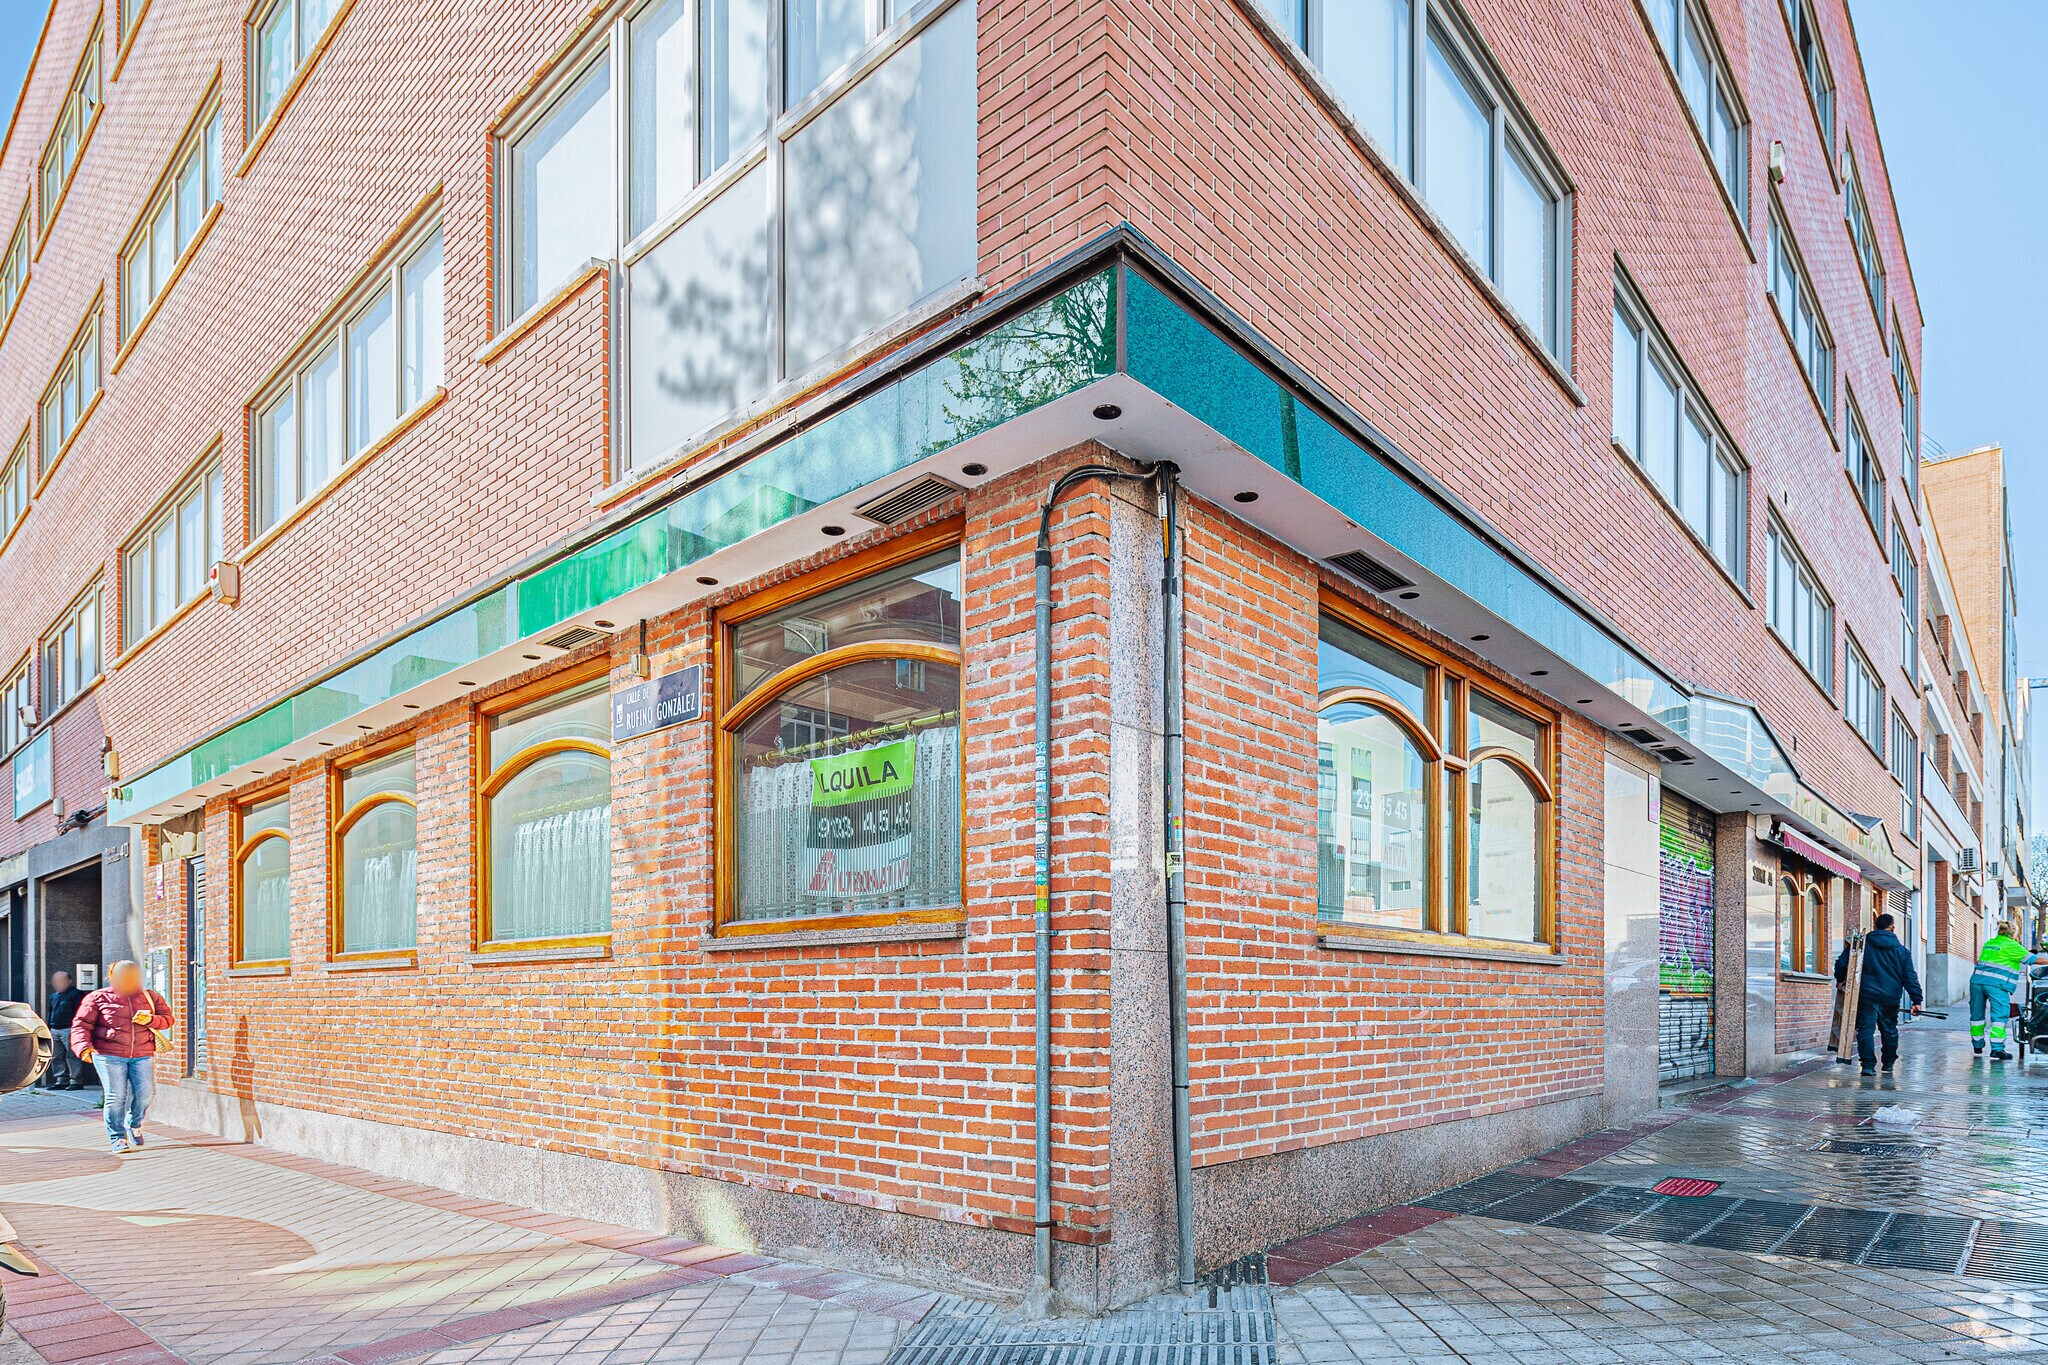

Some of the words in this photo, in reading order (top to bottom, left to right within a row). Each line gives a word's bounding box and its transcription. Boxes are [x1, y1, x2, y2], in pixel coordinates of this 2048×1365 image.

[626, 689, 641, 705] CALLE
[642, 687, 650, 700] DE
[626, 706, 653, 730] RUFINO
[656, 692, 695, 721] GONZÁLEZ
[816, 760, 899, 793] LQUILA
[1394, 799, 1408, 821] 45
